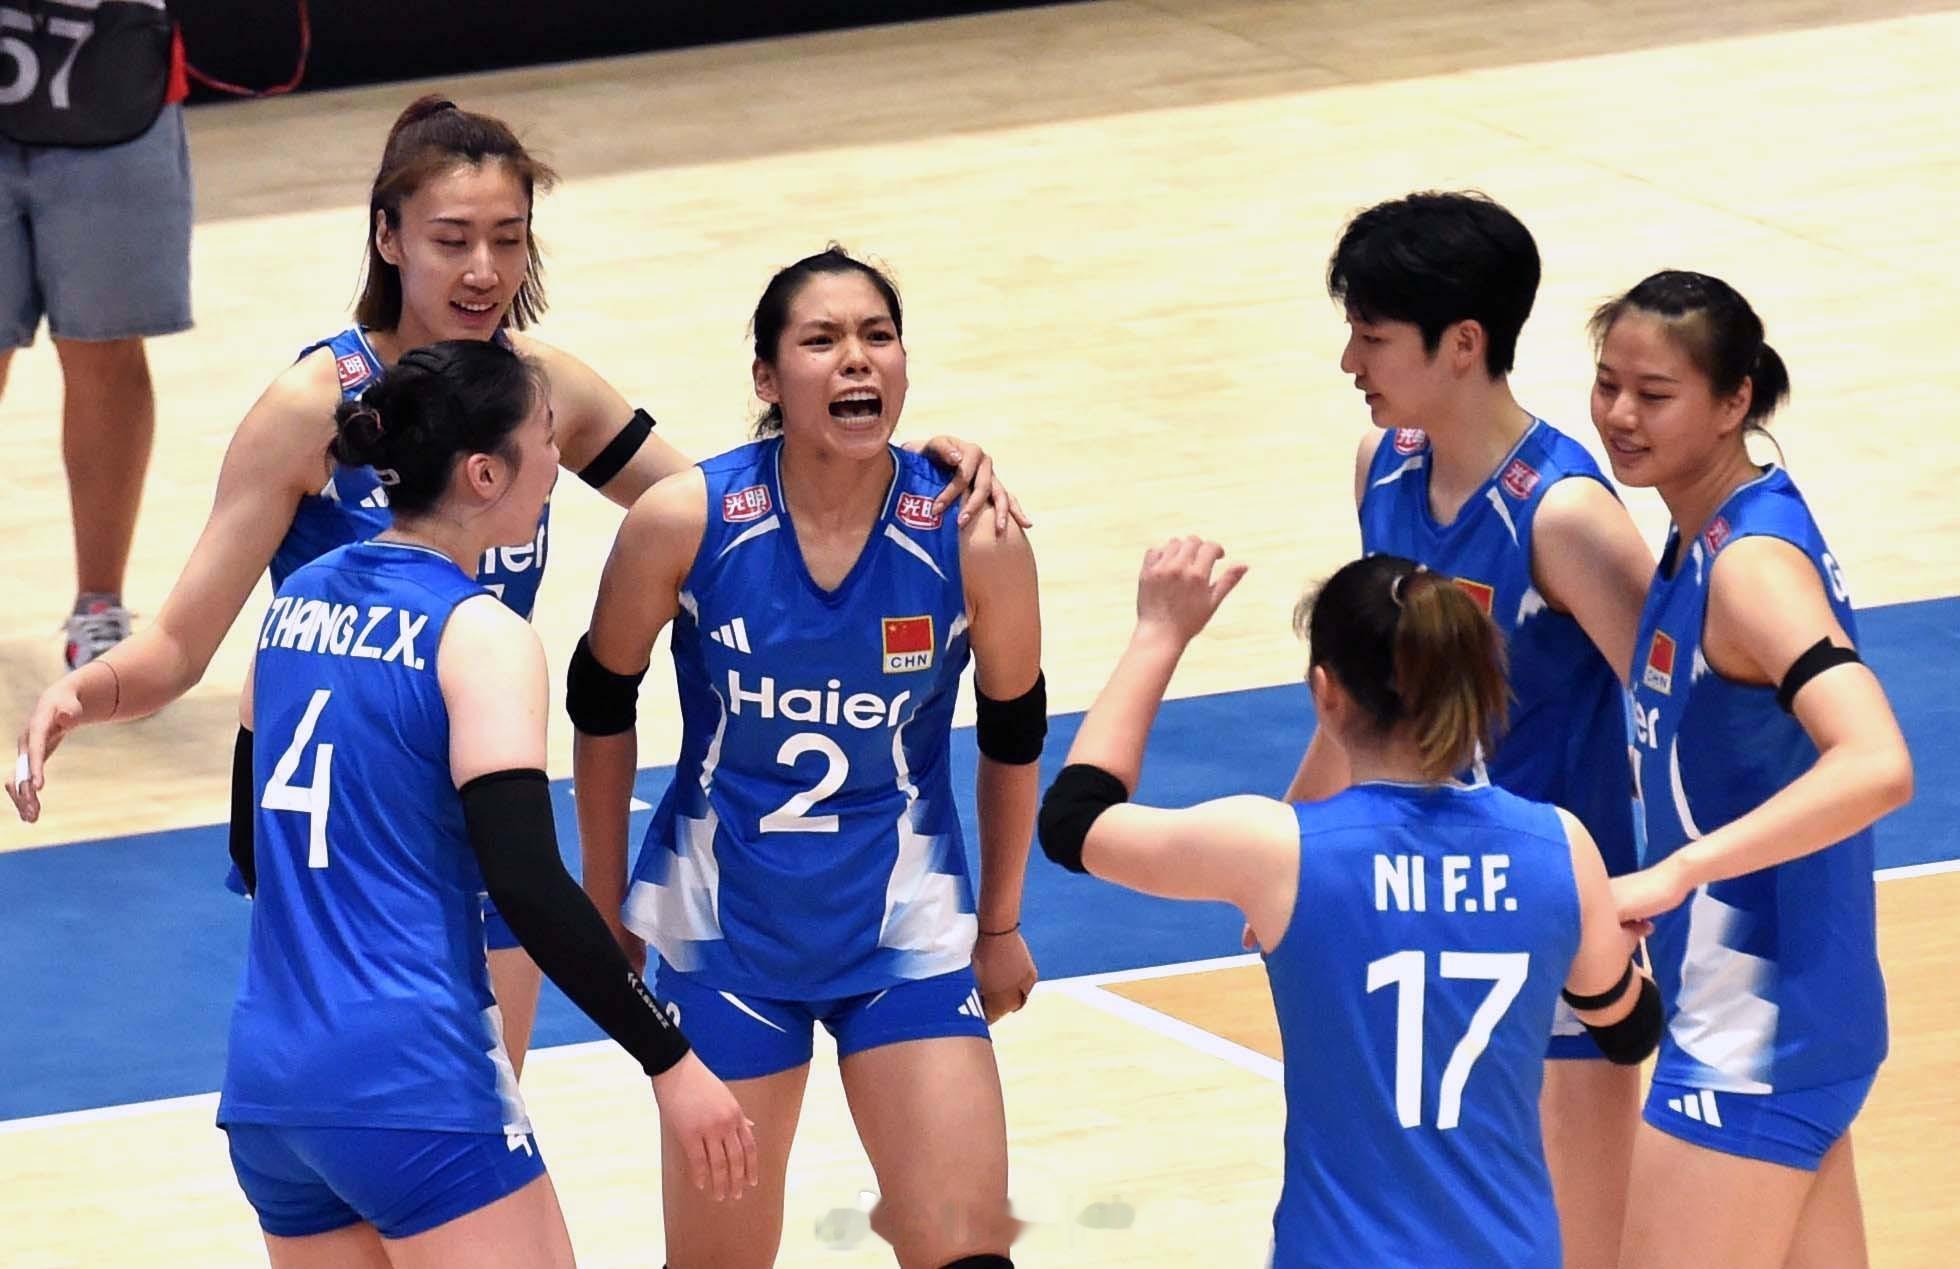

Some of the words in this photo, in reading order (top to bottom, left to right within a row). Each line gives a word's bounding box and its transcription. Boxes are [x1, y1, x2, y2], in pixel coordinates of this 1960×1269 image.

[726, 489, 766, 515] 光明
[477, 523, 546, 573] ier
[260, 597, 358, 656] ZHANG
[890, 654, 928, 668] CHN
[728, 669, 910, 728] Haier
[261, 689, 334, 868] 4
[760, 733, 849, 833] 2
[1374, 854, 1426, 912] NI
[1442, 854, 1518, 912] F.F.
[1366, 951, 1529, 1129] 17
